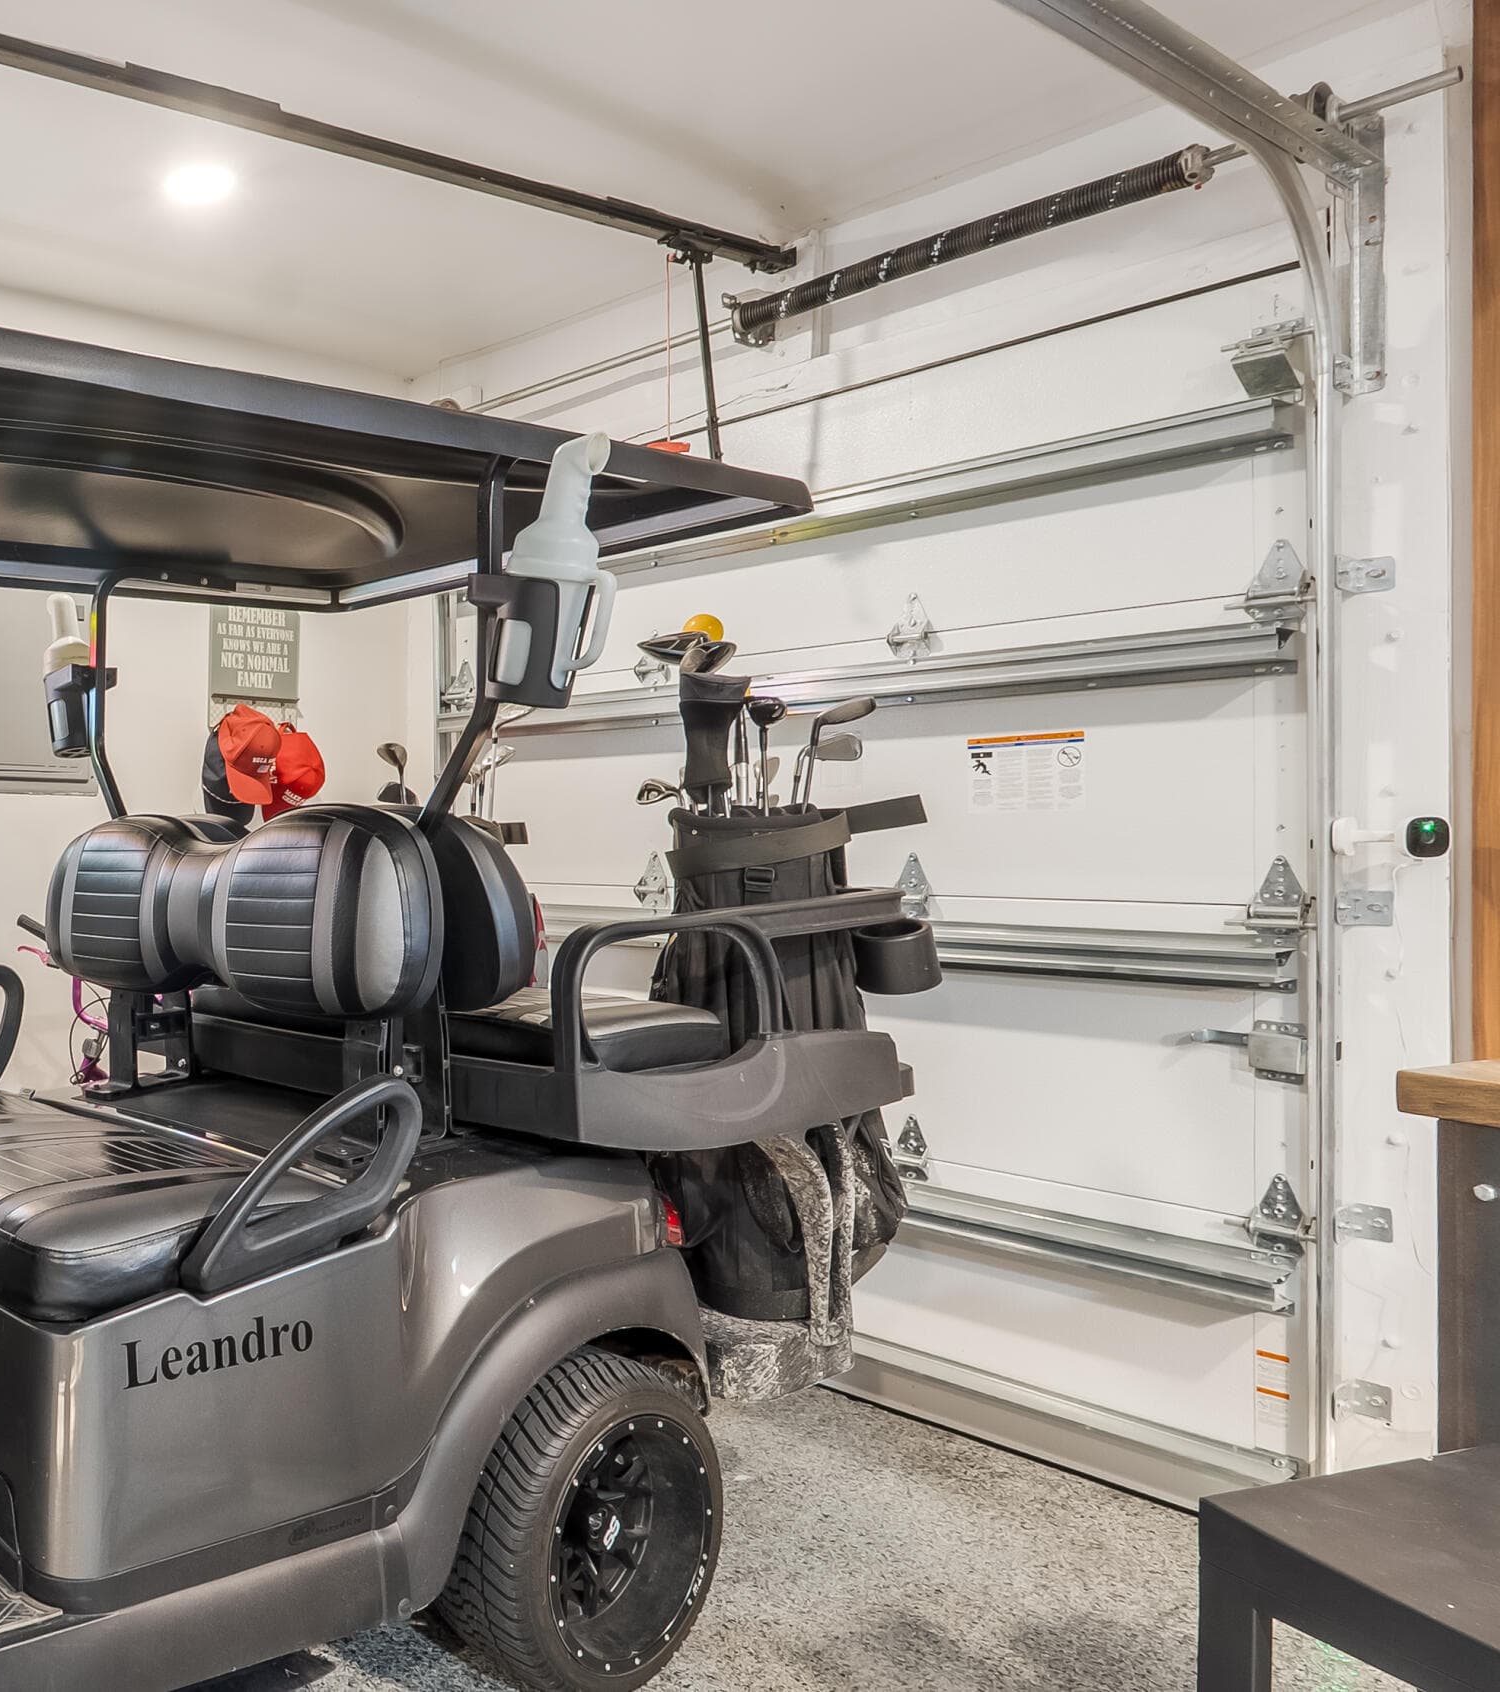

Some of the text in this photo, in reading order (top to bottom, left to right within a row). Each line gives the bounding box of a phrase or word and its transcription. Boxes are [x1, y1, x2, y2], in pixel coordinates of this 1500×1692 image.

[228, 606, 285, 627] REMEMBER
[217, 622, 294, 641] AS FAR AS EVERYONE
[222, 638, 288, 656] KNOWS WE ARE A
[220, 651, 290, 673] NICE NORMAL
[237, 671, 274, 689] FAMILY
[122, 1315, 314, 1390] Leandro
